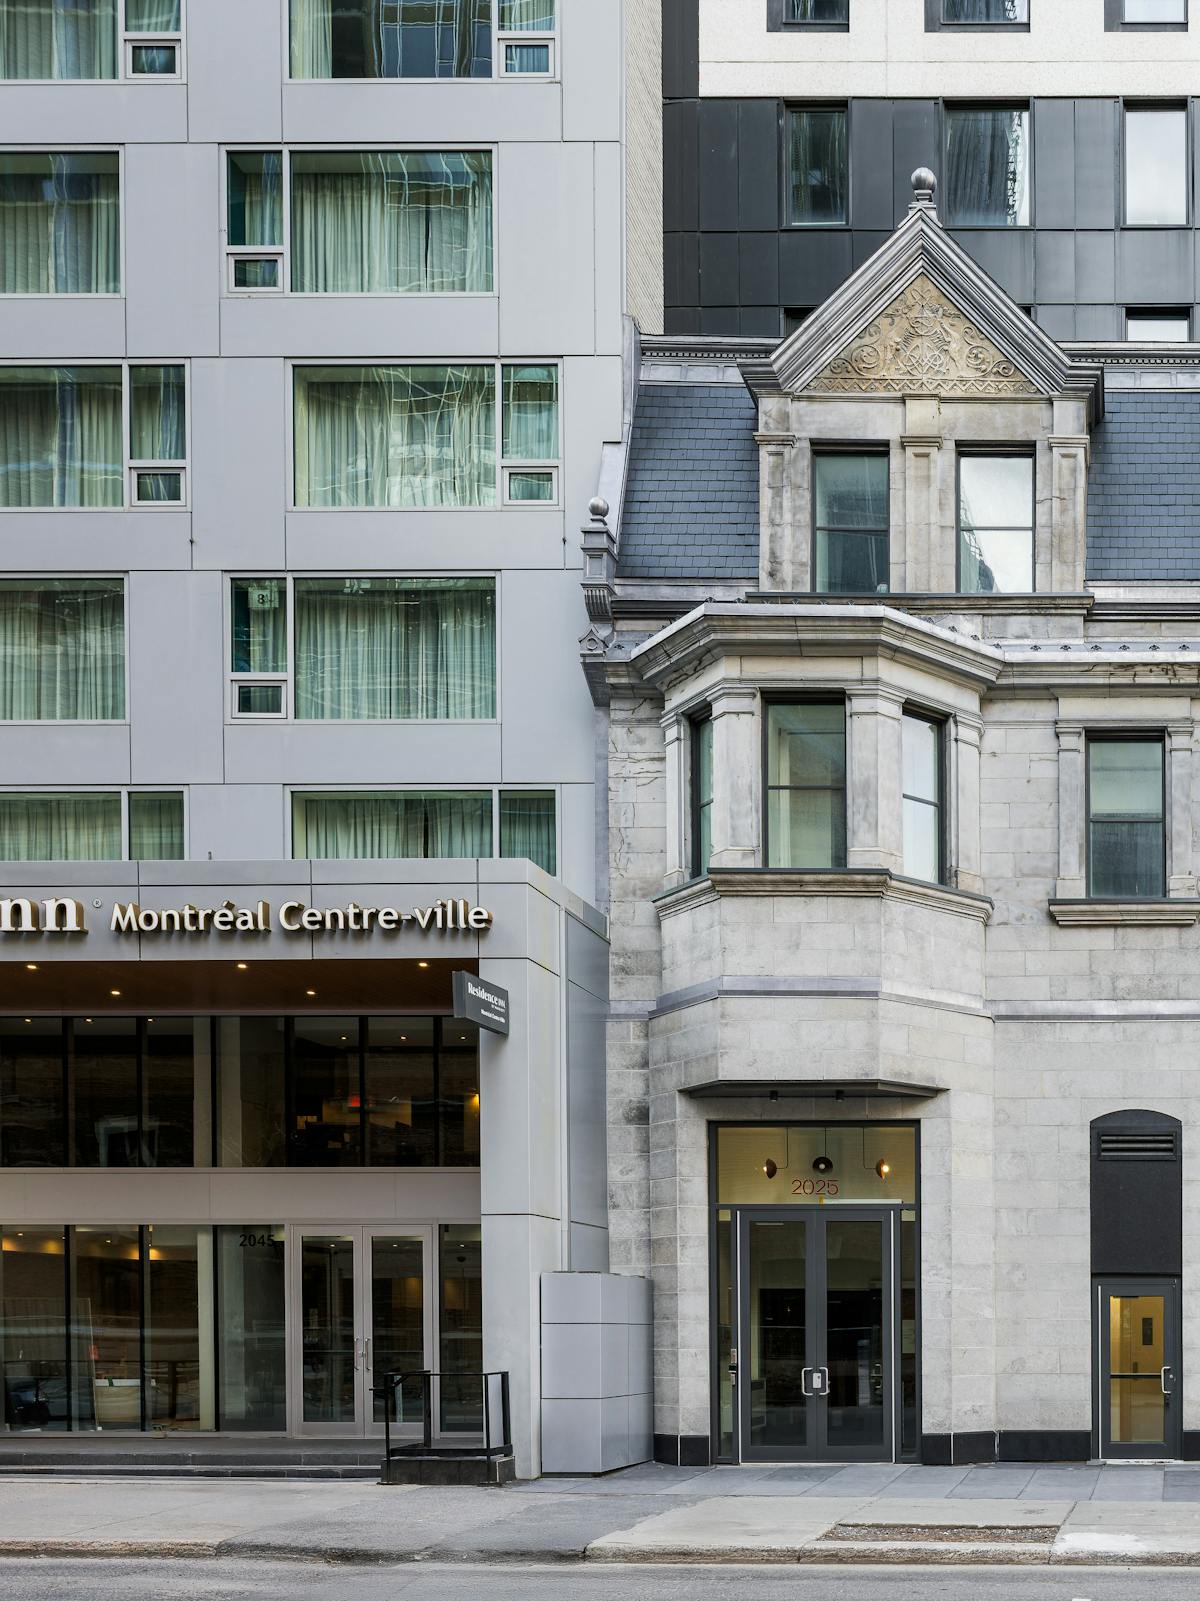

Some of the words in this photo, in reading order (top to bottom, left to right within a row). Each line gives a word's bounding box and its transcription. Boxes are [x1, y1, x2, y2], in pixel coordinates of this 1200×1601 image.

[110, 900, 267, 931] Montréal
[278, 898, 490, 931] Centre-ville
[467, 982, 498, 1005] Residence
[791, 1179, 840, 1195] 2025
[239, 1233, 275, 1247] 2045
